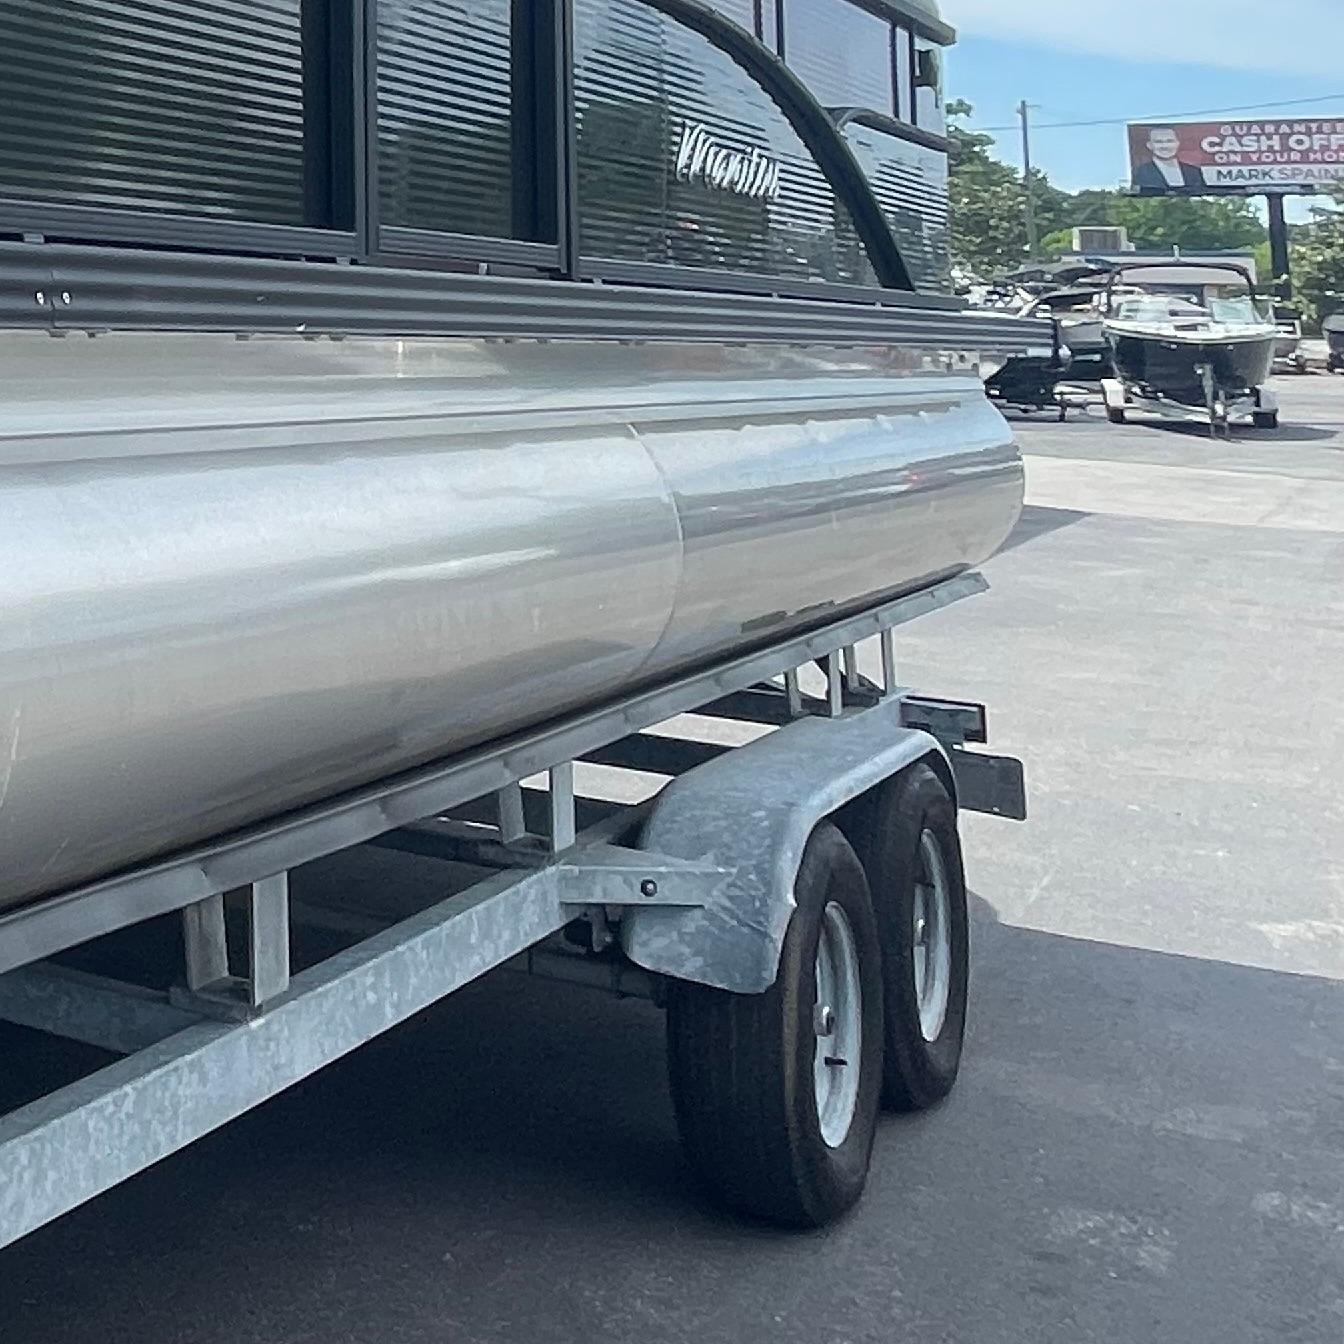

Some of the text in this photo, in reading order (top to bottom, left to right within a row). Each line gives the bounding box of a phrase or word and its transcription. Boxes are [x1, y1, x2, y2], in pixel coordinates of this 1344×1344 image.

[1201, 135, 1281, 153] CASH
[1214, 152, 1243, 164] ON
[1249, 151, 1302, 163] YOUR
[1216, 168, 1275, 182] MARK
